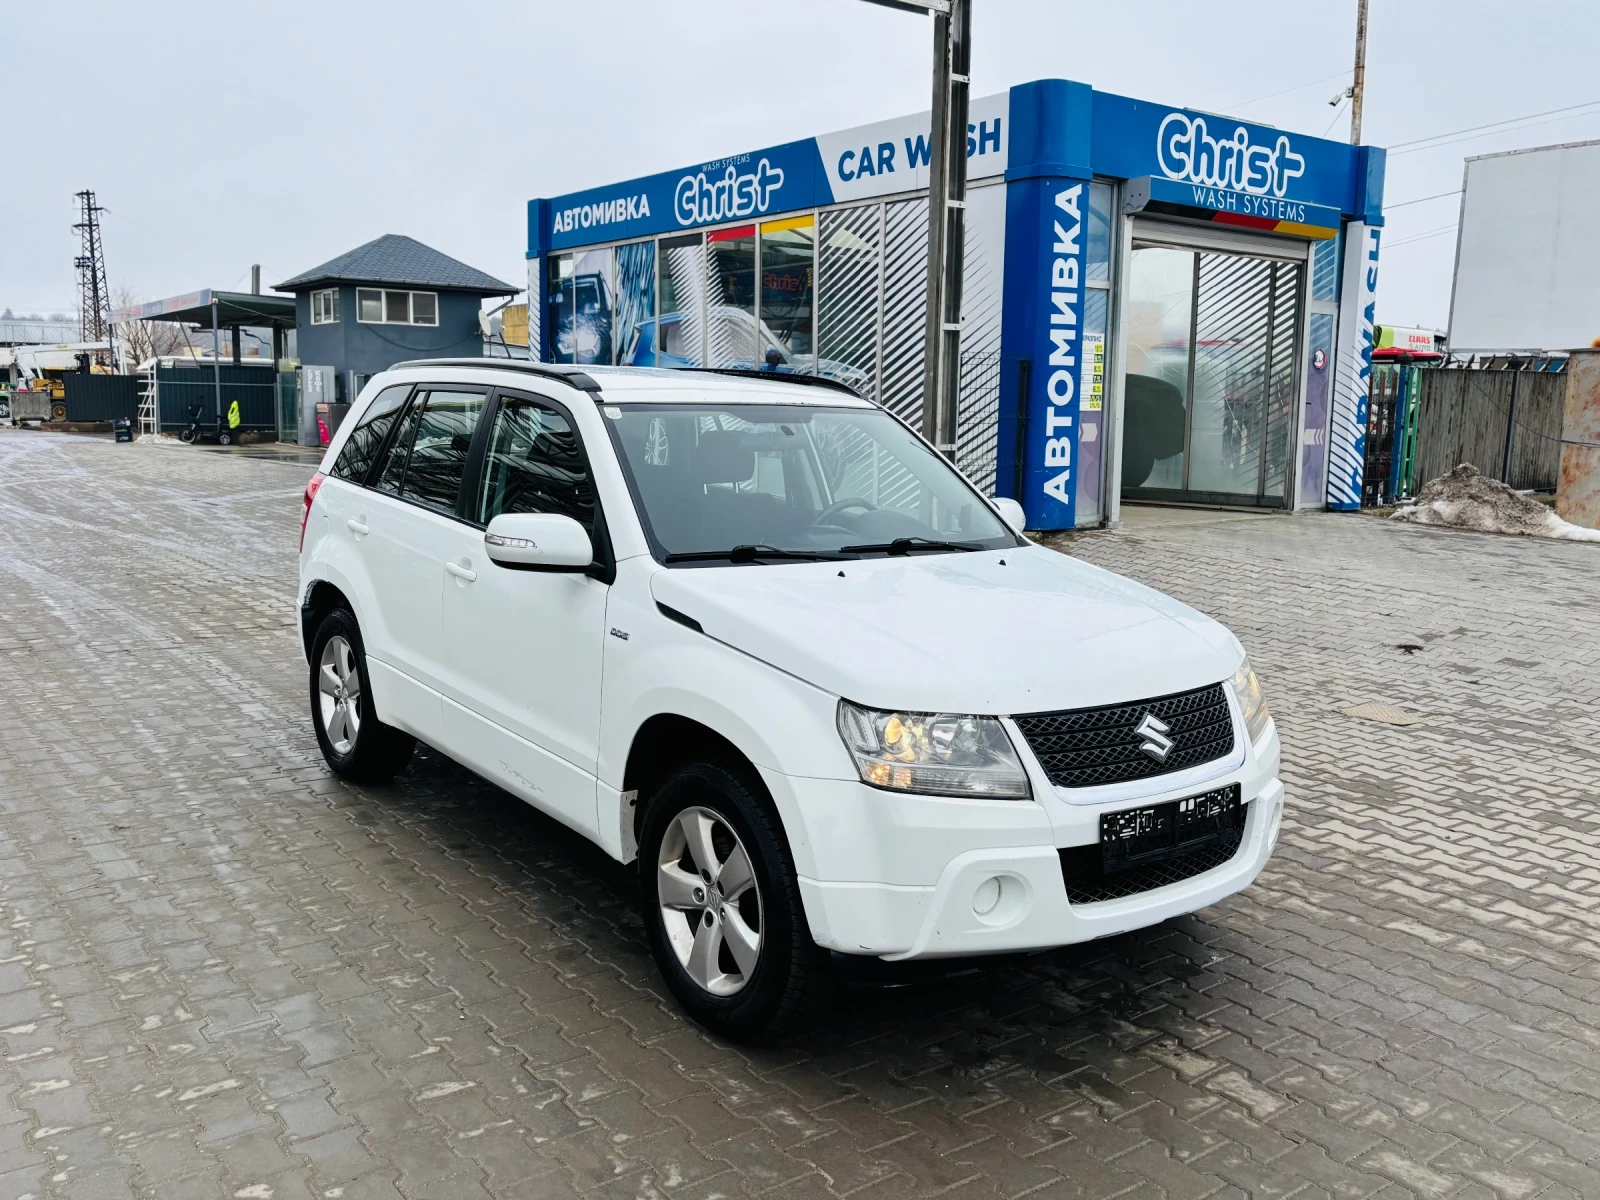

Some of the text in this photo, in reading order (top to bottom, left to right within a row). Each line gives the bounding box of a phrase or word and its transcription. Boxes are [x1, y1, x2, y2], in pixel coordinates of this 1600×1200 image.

[702, 154, 751, 173] WASH SYSTEMS
[838, 118, 1001, 182] CAR WSH
[1157, 112, 1305, 198] Christ
[674, 158, 784, 226] Christ
[1193, 186, 1305, 222] WASH SYSTEMS
[553, 193, 650, 234] АВТОМИВКА
[1043, 183, 1082, 505] АВТОМИВКА
[1408, 335, 1431, 344] CLAAS
[314, 370, 322, 392] КАФЕ
